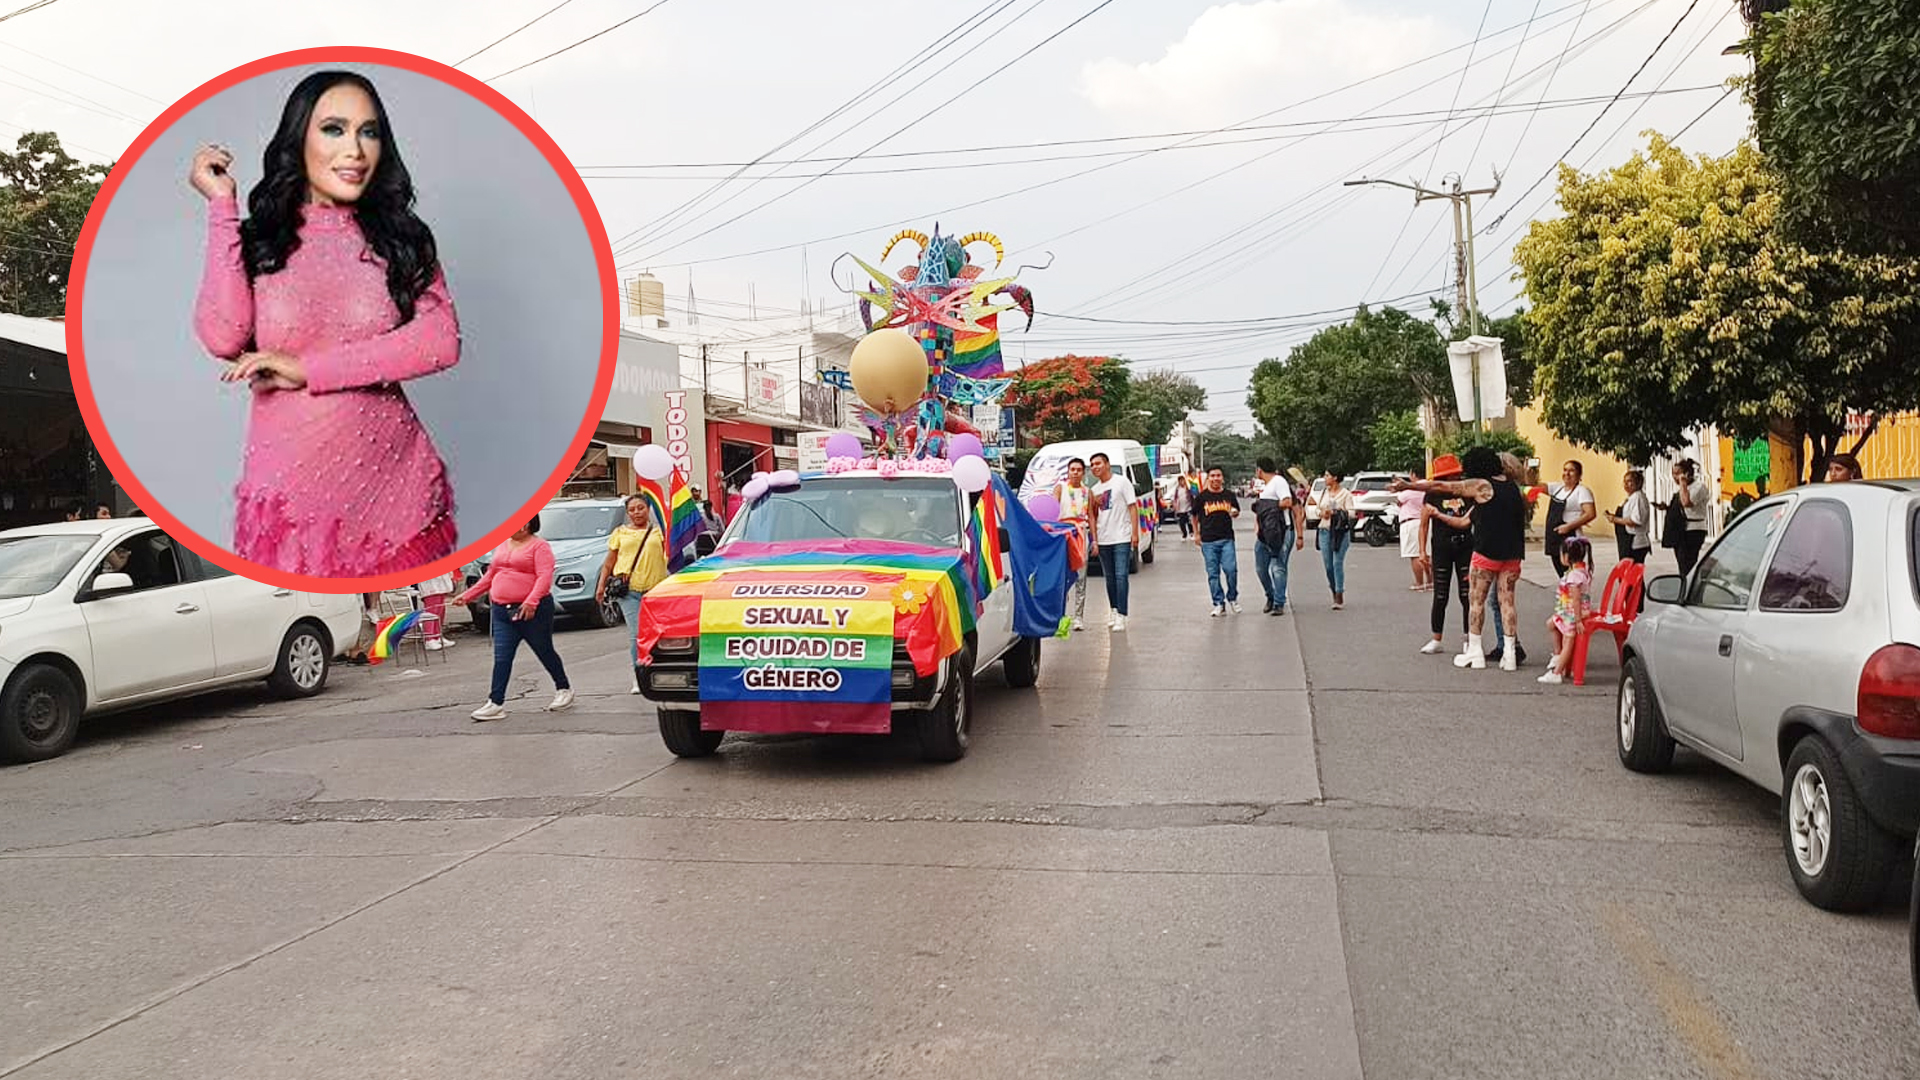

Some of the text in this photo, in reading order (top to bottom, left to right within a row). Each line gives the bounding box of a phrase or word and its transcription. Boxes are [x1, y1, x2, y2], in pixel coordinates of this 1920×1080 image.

[734, 585, 867, 597] DIVERSIDAD
[745, 607, 850, 626] SEXUAL Y
[727, 638, 864, 659] EQUIDAD DE
[745, 665, 841, 689] GÉNERO
